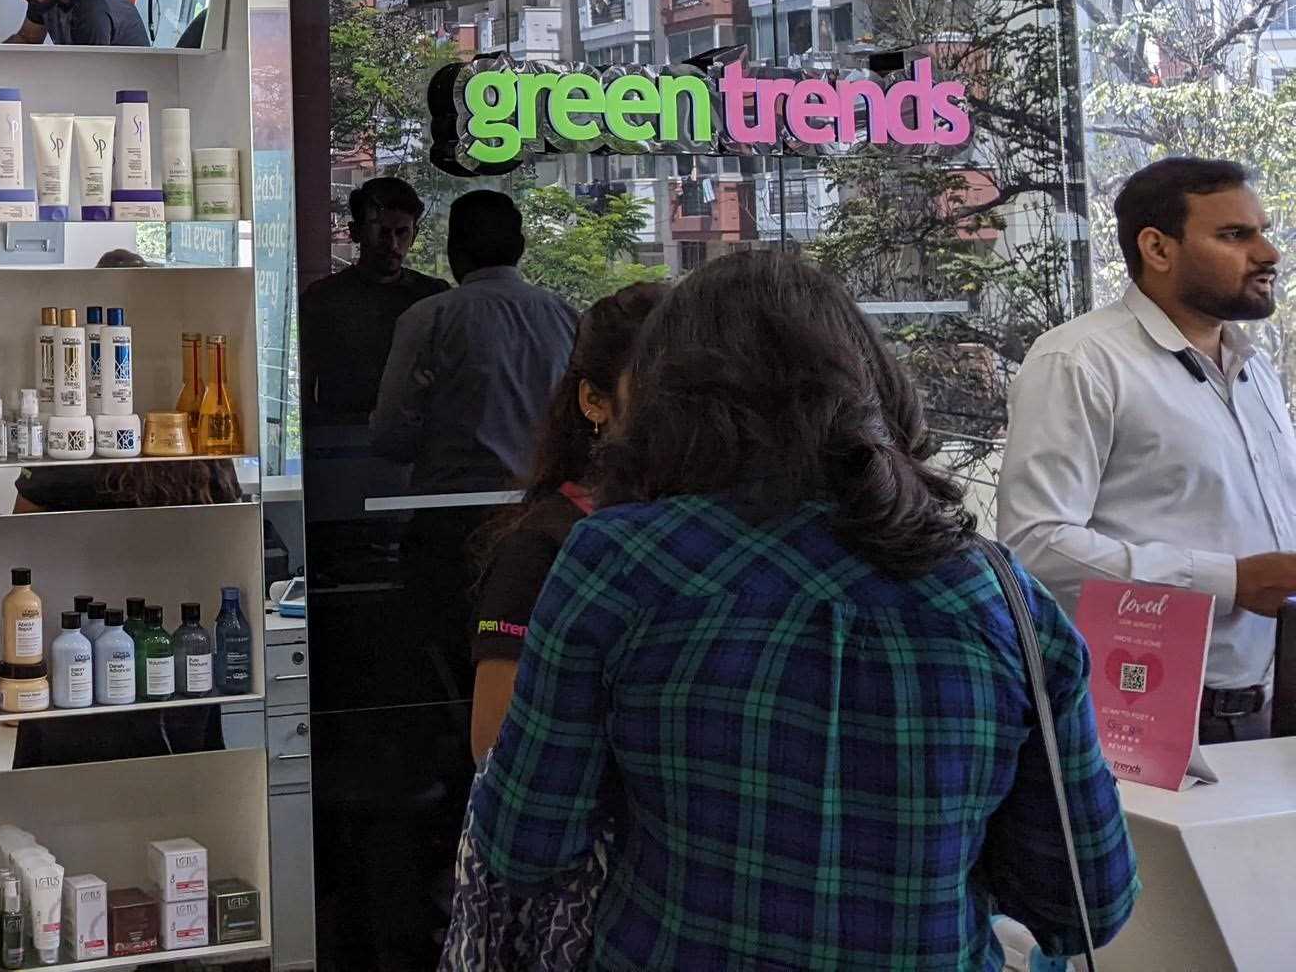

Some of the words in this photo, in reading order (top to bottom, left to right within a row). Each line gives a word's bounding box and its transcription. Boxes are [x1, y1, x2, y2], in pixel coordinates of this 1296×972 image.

[464, 67, 713, 164] green
[718, 57, 971, 147] trends
[1117, 589, 1169, 617] loved
